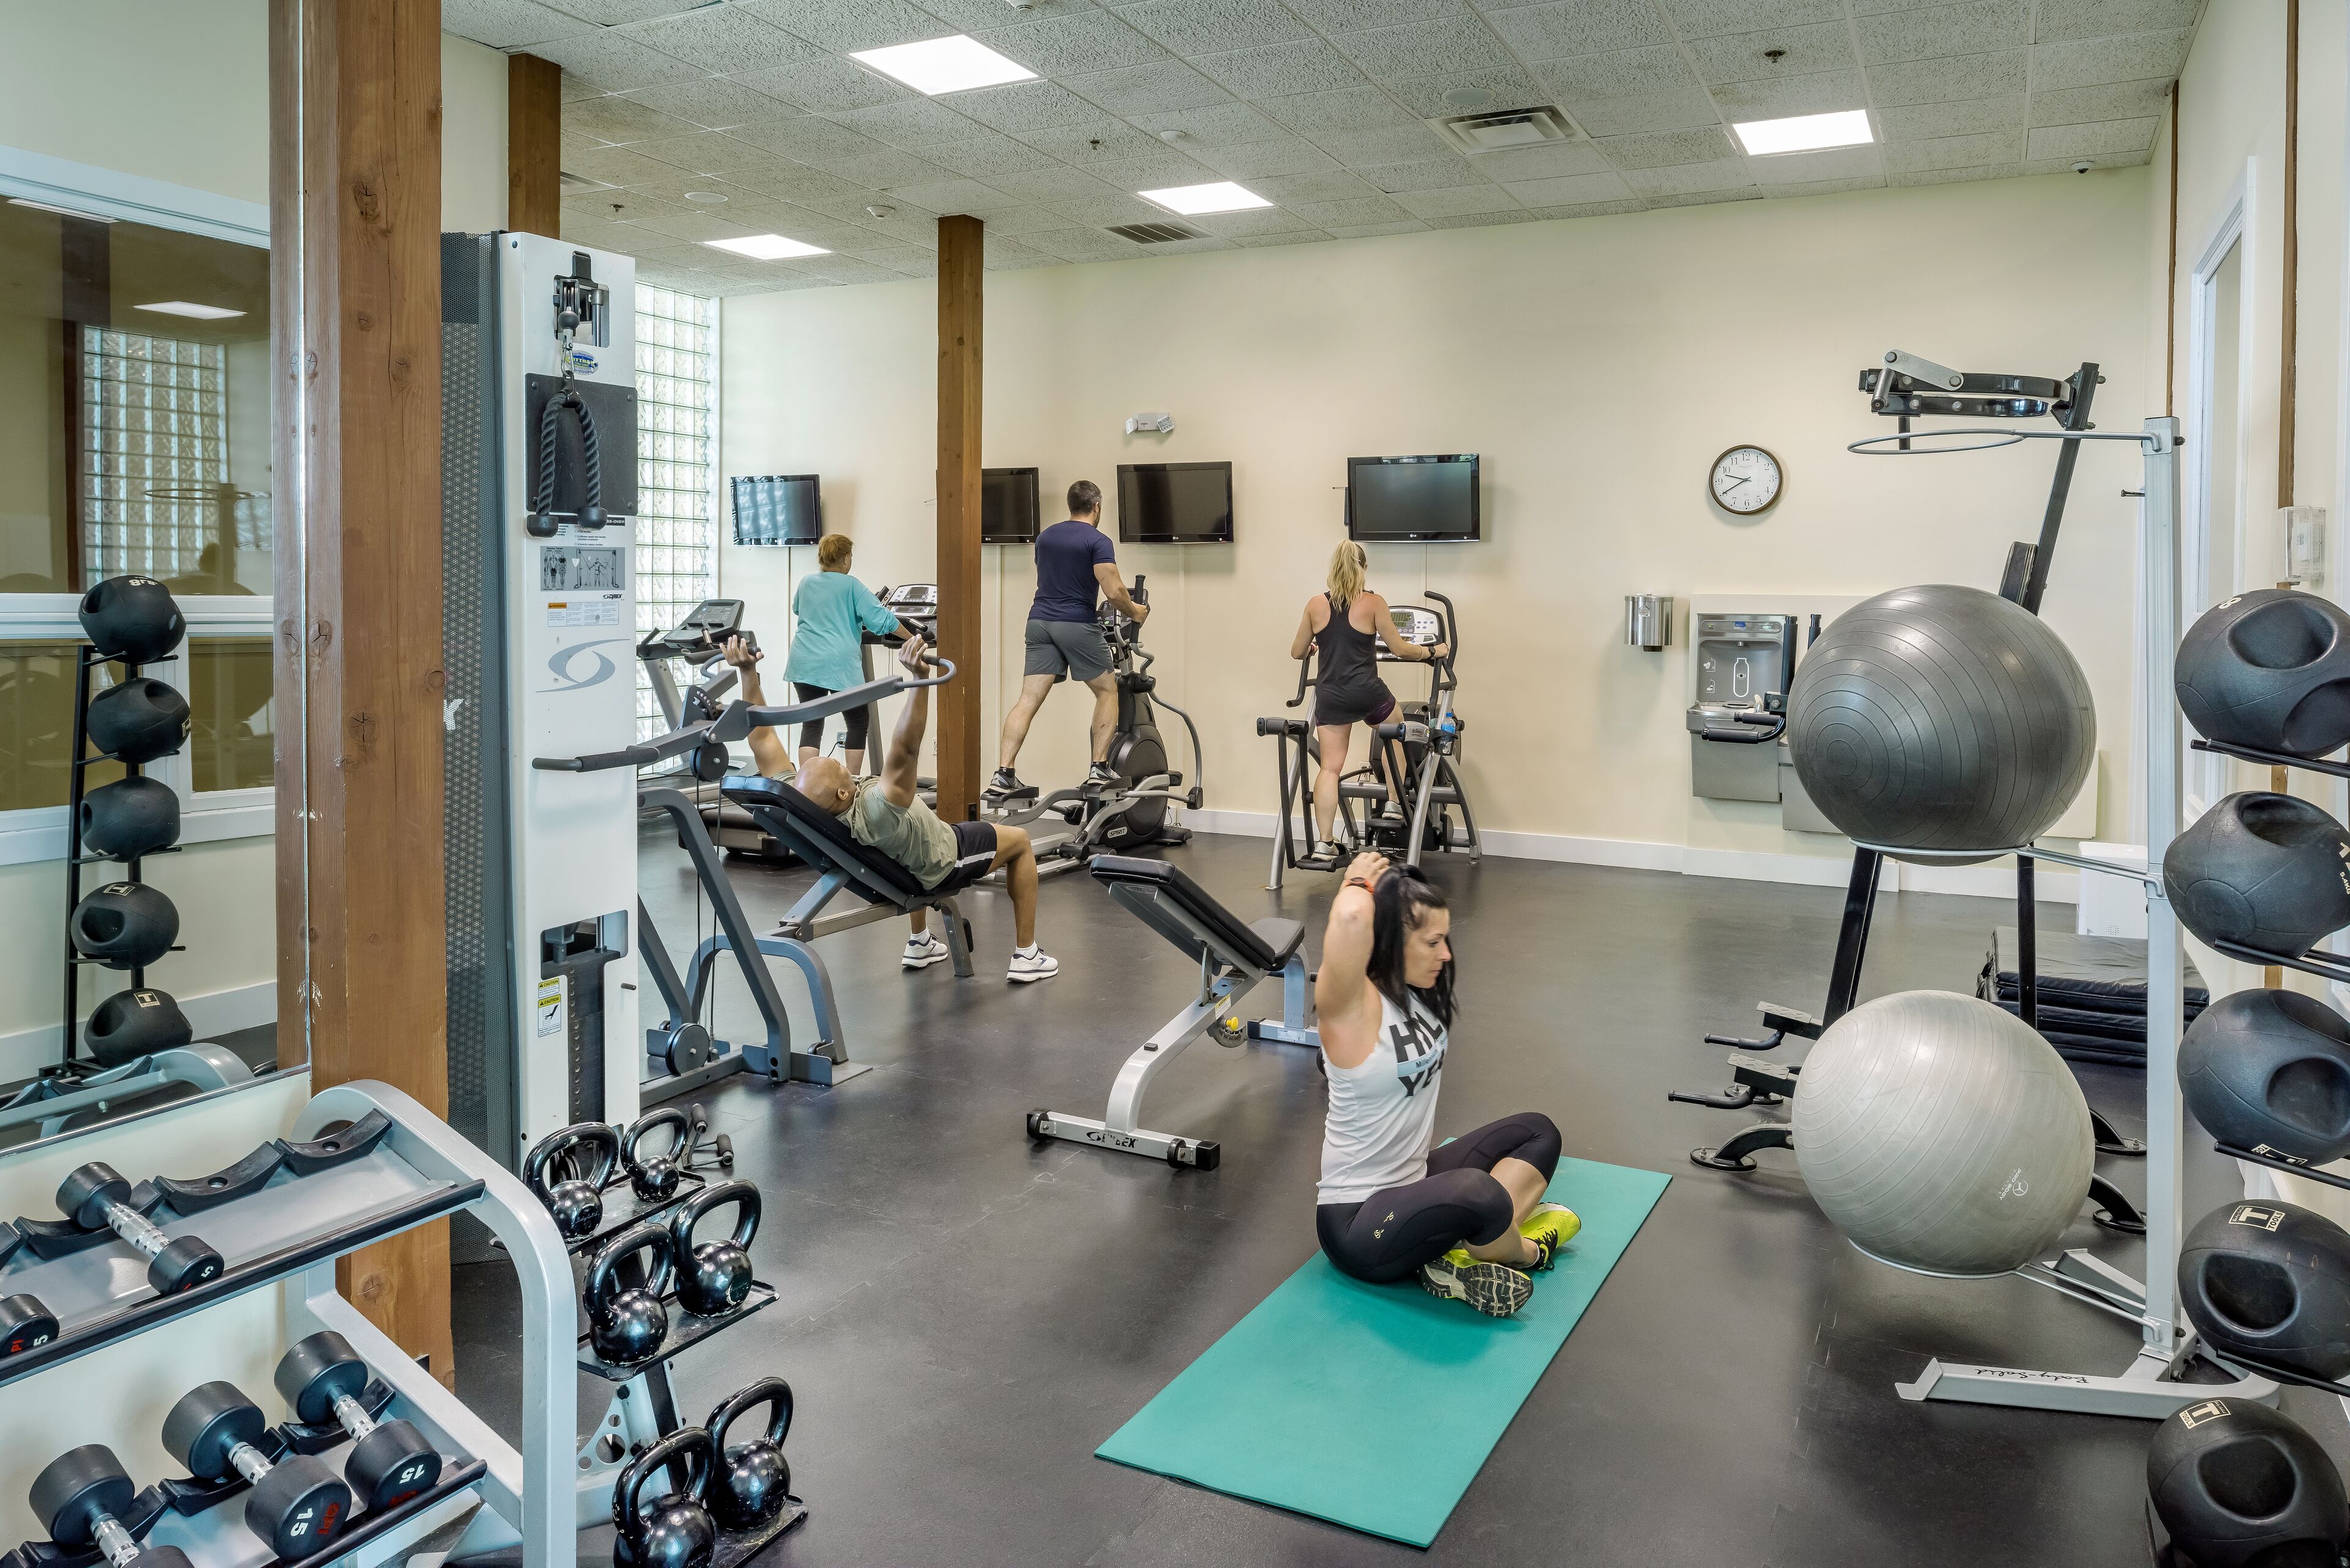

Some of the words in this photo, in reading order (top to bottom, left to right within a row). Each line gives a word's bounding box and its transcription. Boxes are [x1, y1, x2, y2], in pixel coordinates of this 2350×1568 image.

[1110, 828, 1125, 837] SPIRIT
[2012, 1168, 2022, 1182] PRO
[1999, 1183, 2012, 1201] BODY
[2268, 1212, 2283, 1230] TOOLS
[201, 1265, 214, 1278] 5
[34, 1335, 48, 1346] 5
[2181, 1411, 2194, 1427] TOOLS
[399, 1464, 425, 1484] 15
[291, 1507, 313, 1537] 15
